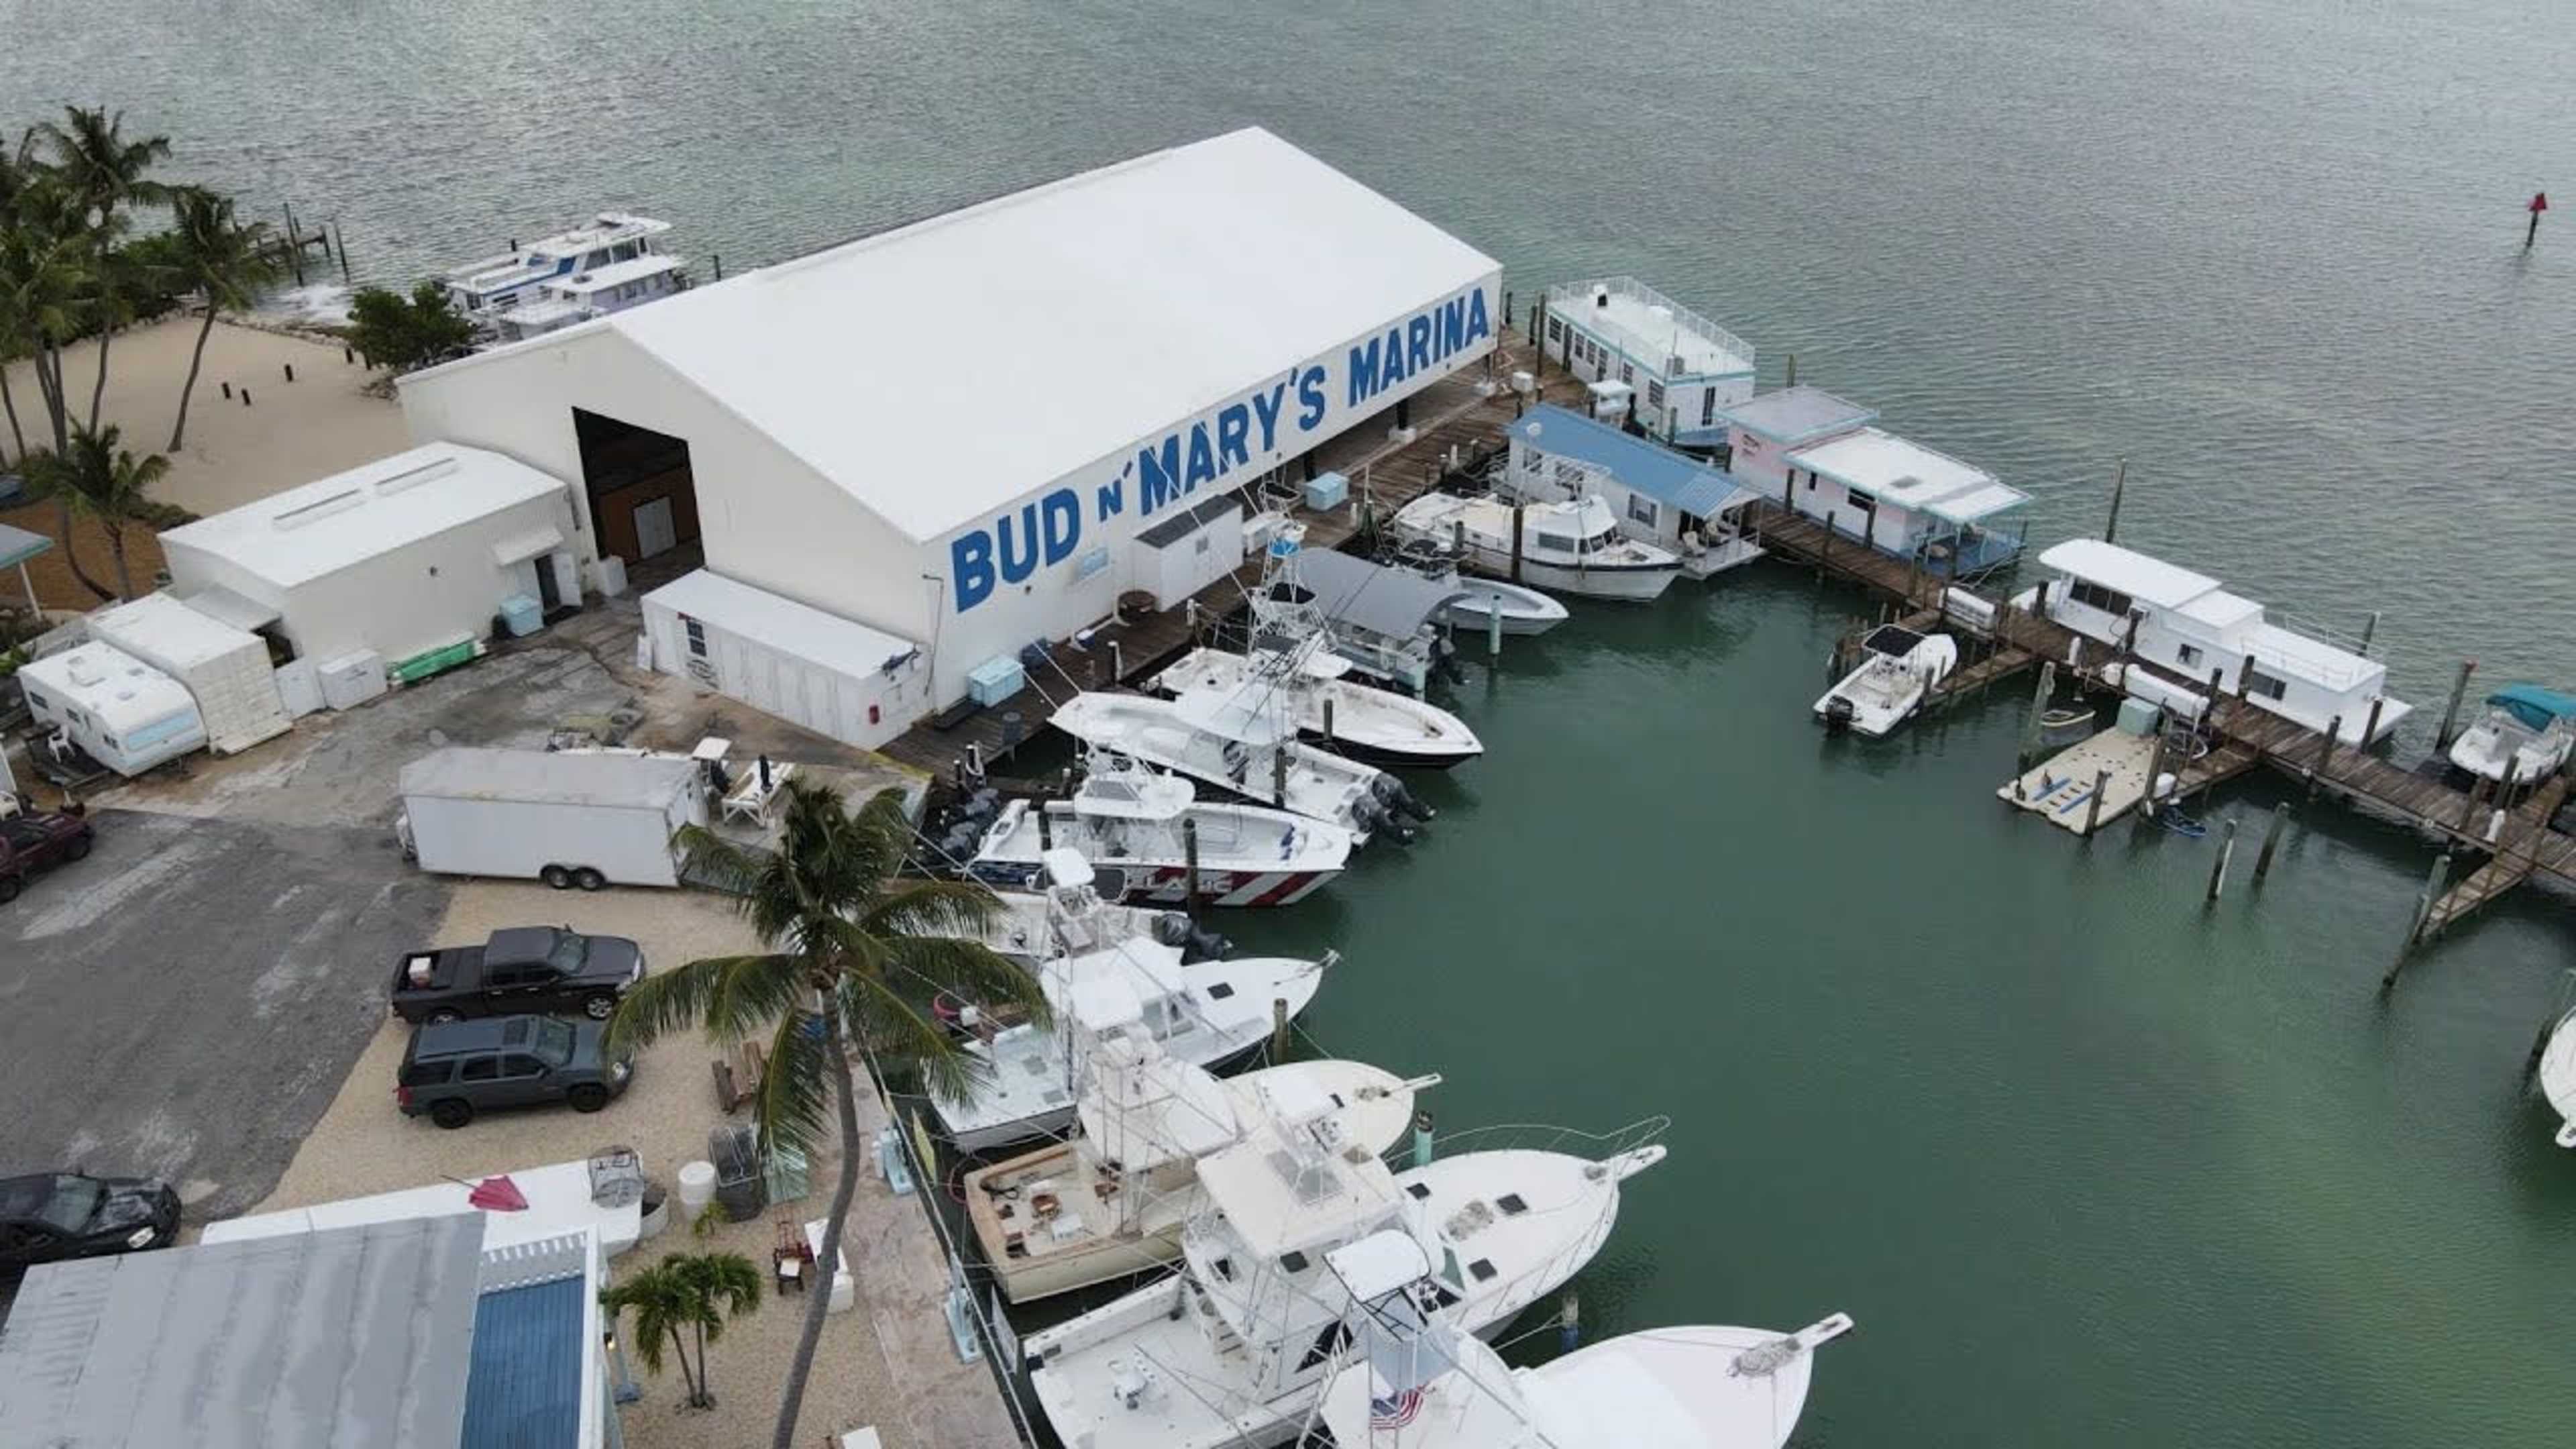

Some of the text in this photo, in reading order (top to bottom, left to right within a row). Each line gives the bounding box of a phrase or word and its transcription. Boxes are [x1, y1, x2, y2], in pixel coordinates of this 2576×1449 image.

[950, 488, 1081, 614] BUD
[1138, 366, 1328, 516] MARY'S
[1348, 288, 1489, 407] MARINA
